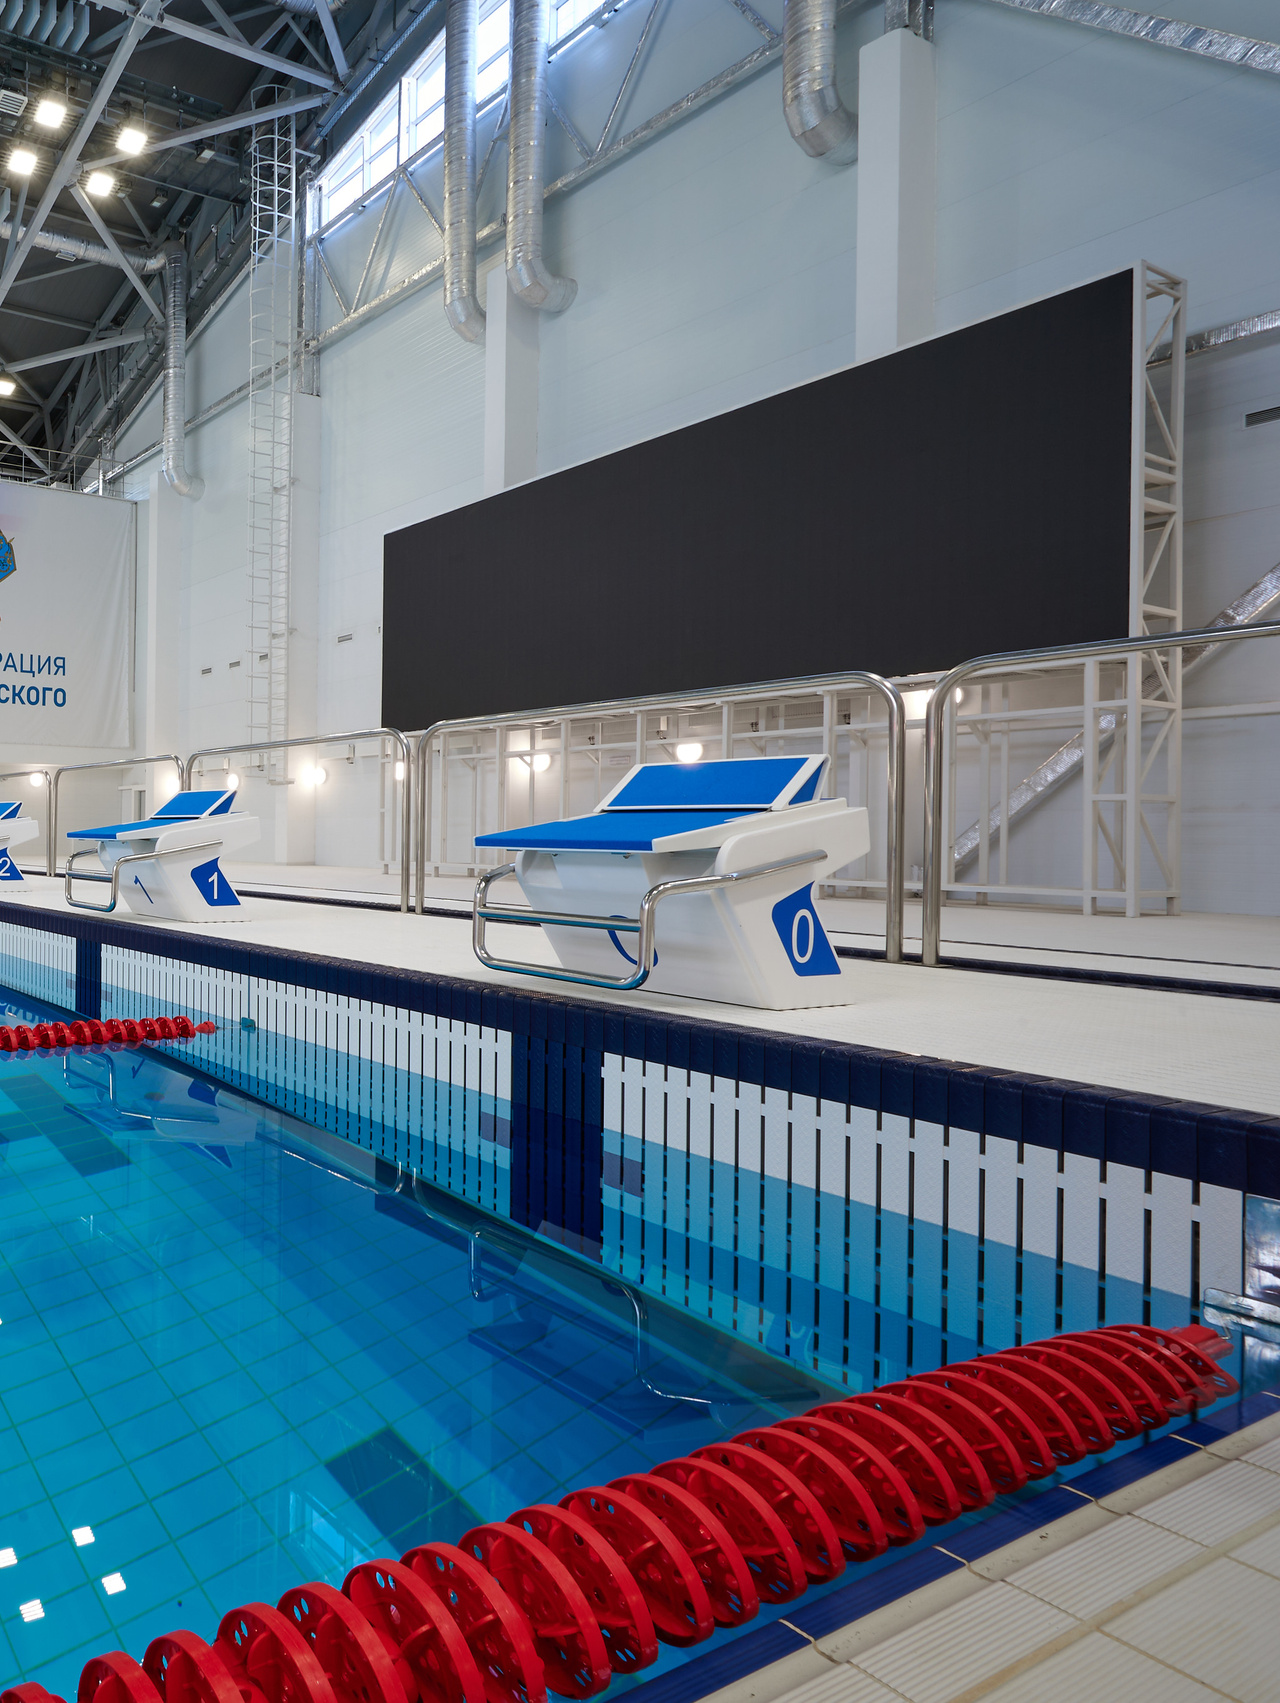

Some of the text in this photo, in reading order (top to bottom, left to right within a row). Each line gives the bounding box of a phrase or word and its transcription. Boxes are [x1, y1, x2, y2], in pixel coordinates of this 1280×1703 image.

[133, 875, 154, 904] 1
[208, 871, 218, 900] 1
[791, 908, 815, 963] 0
